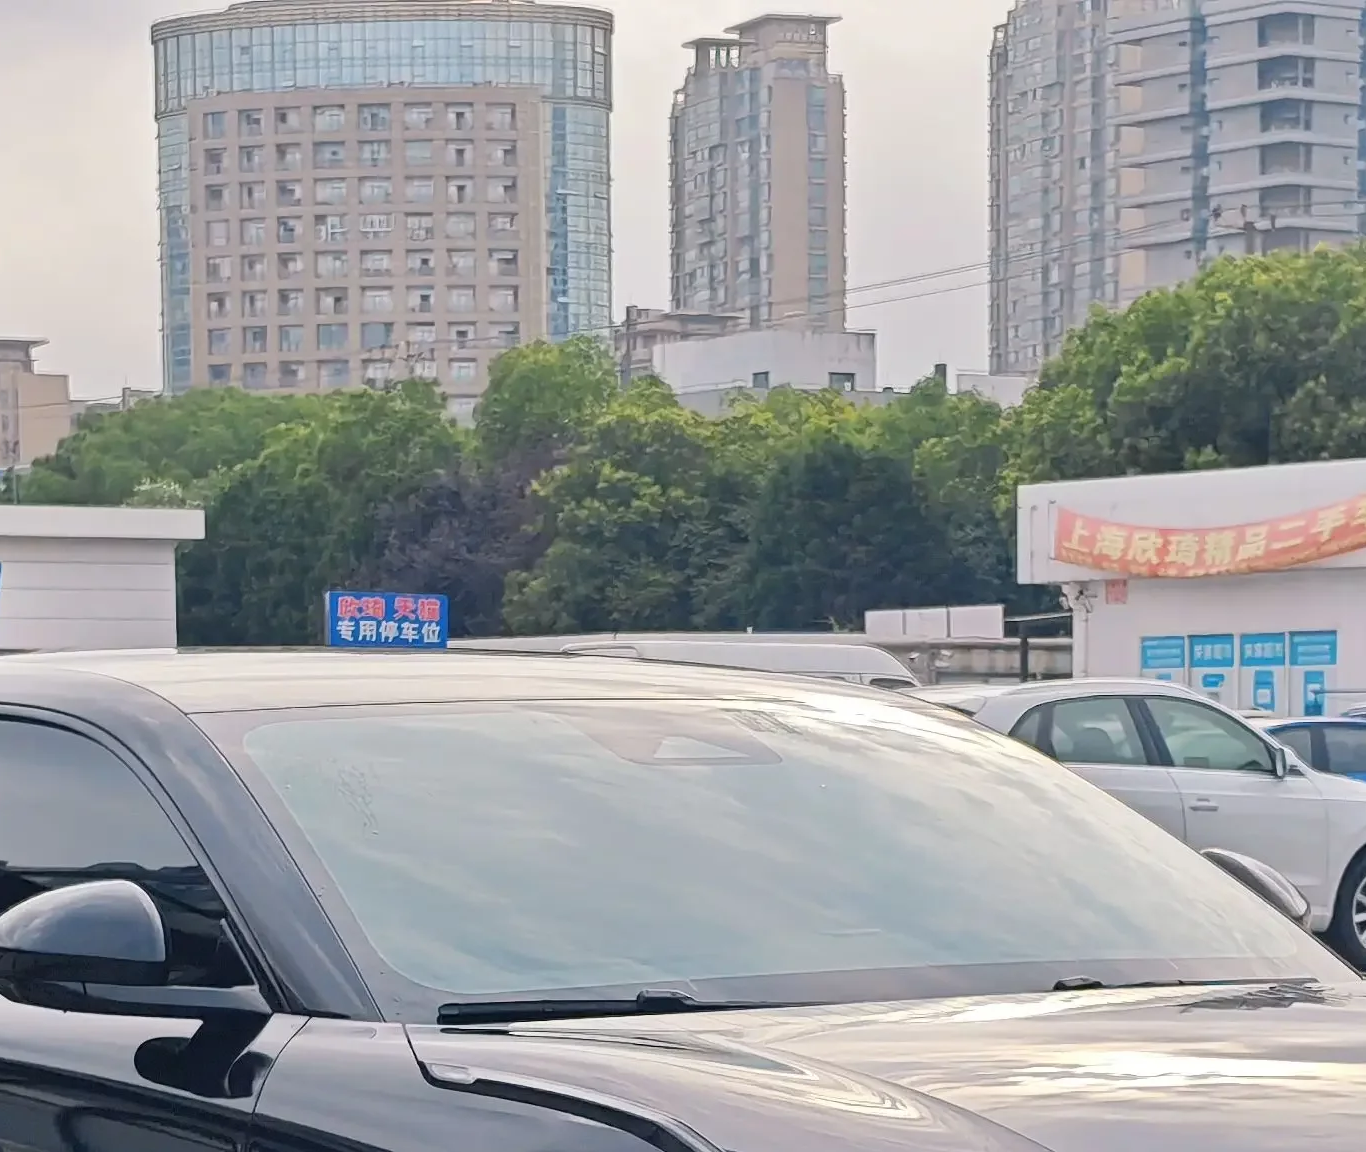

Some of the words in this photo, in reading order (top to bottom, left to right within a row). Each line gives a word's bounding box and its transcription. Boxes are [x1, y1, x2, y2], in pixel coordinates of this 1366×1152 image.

[337, 620, 441, 642] 专用停车位
